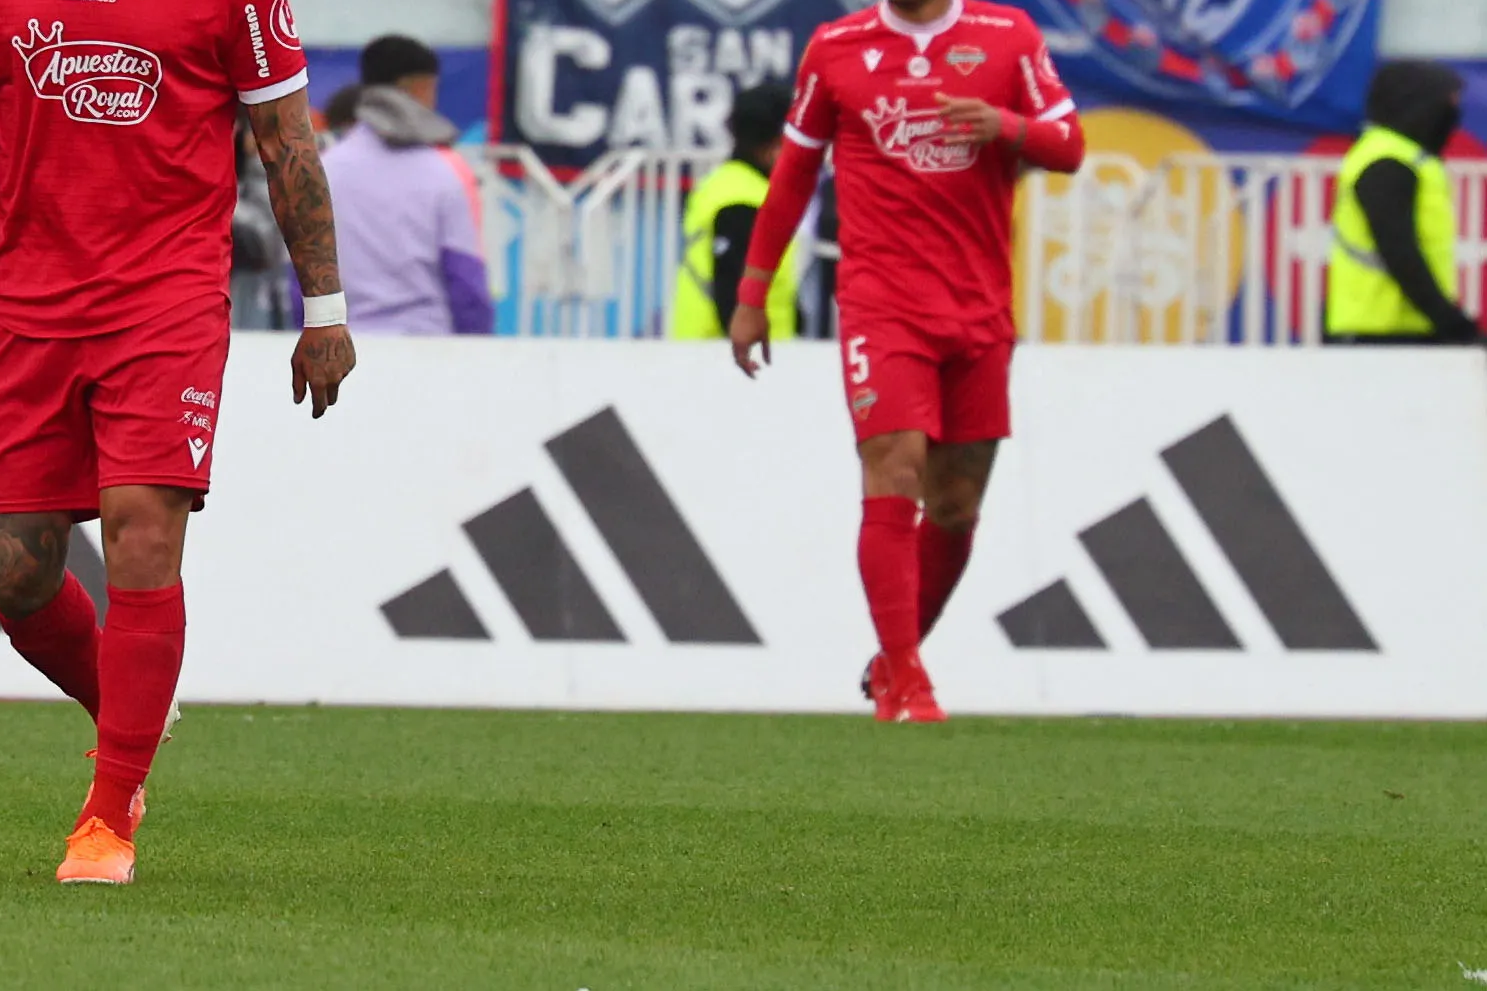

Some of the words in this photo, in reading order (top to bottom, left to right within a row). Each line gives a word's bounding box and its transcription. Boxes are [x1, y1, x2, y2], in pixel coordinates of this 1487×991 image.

[244, 3, 270, 78] CURIMAPU
[38, 49, 152, 90] Apuestas
[71, 84, 143, 118] Royal
[848, 335, 869, 384] 5
